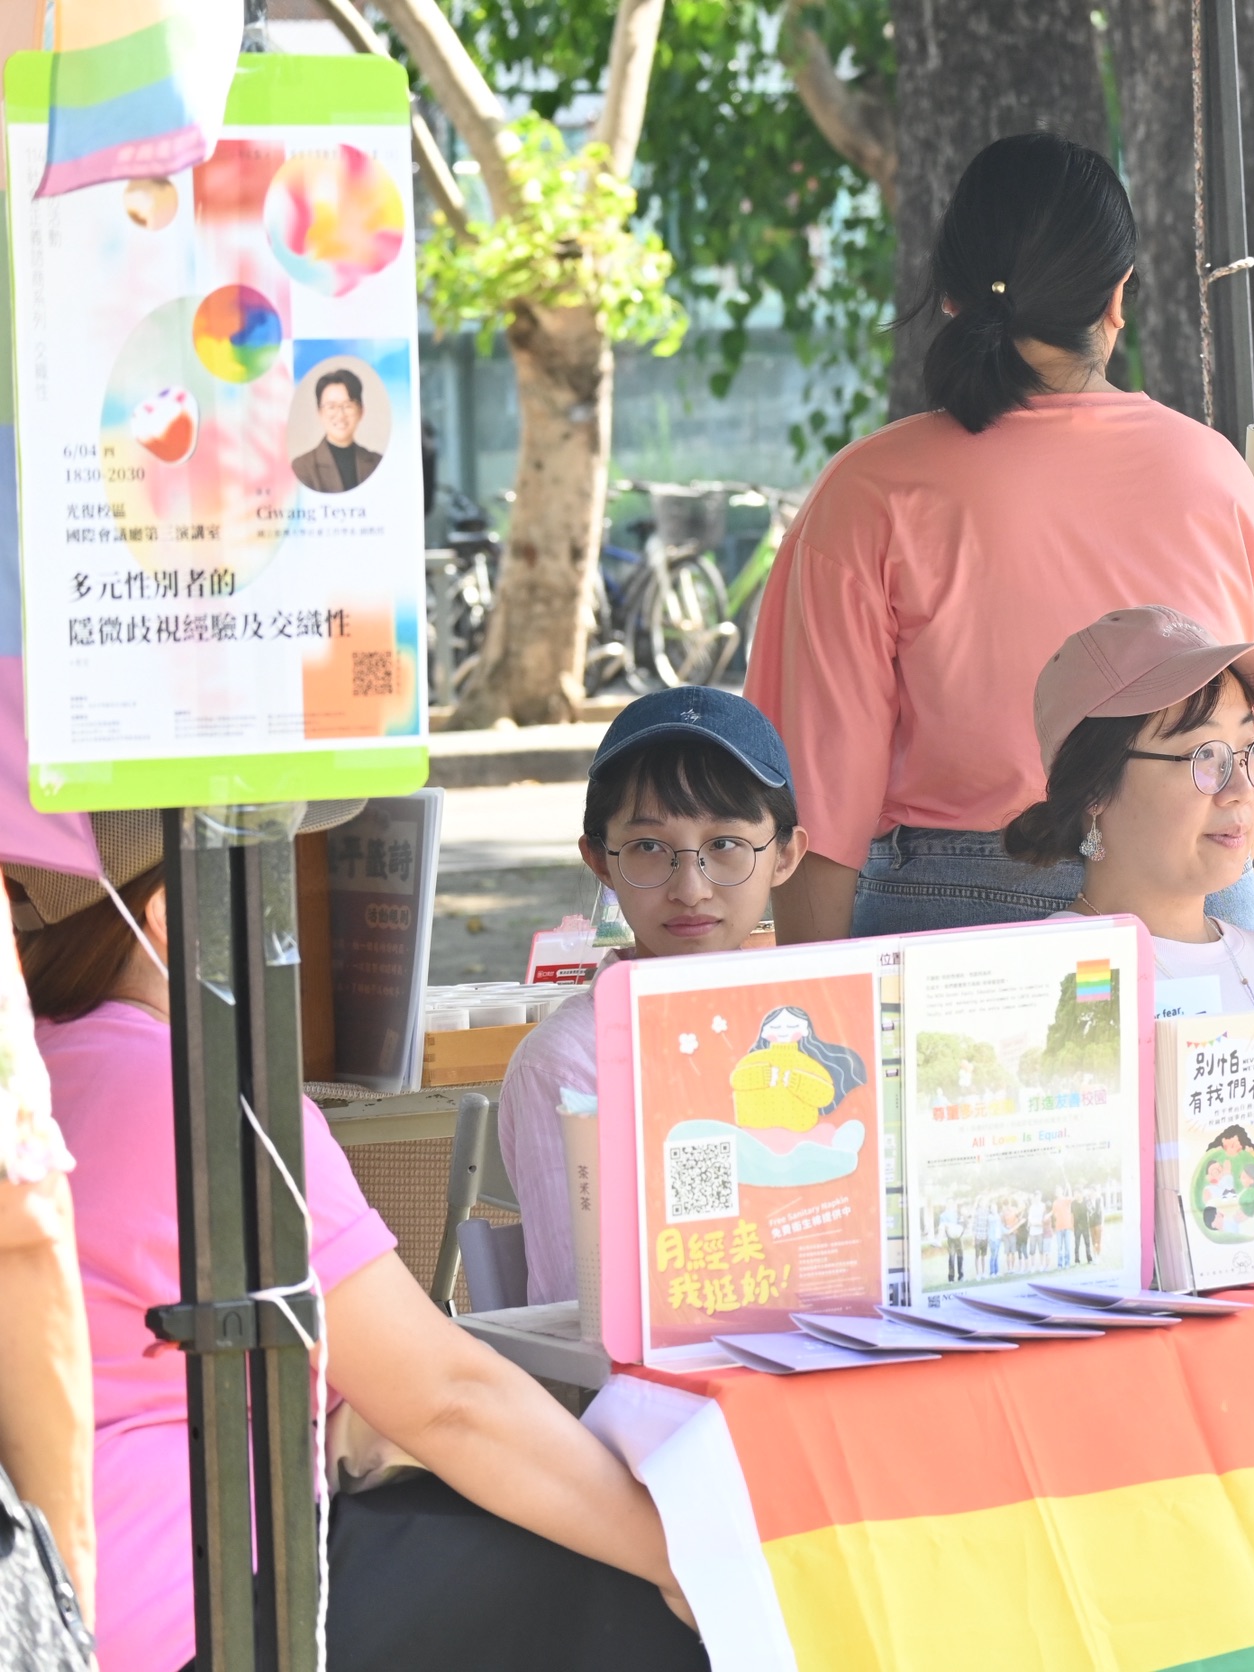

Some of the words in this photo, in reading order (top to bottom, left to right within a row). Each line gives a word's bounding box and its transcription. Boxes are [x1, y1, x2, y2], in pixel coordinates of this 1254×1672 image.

[63, 443, 97, 459] 6/04
[66, 467, 146, 483] 1830-2030
[66, 502, 126, 520] 光復校區
[256, 504, 316, 521] Ciwang
[320, 504, 366, 522] Teyra
[66, 524, 221, 545] 國際會議廳第三演講室
[68, 568, 236, 603] 多元性別者的
[69, 608, 351, 647] 隱微歧視經驗及交織性
[1162, 1007, 1184, 1018] fear,
[1194, 1049, 1240, 1081] 別怕
[1027, 1089, 1108, 1113] 打造友善校園
[972, 1137, 985, 1149] All
[992, 1134, 1017, 1146] Love
[1022, 1132, 1032, 1143] Is
[1038, 1127, 1070, 1142] Equal.
[769, 1215, 786, 1227] Free
[787, 1206, 820, 1221] Sanitary
[821, 1196, 849, 1210] Napkin
[667, 1263, 791, 1316] 我挺妳!
